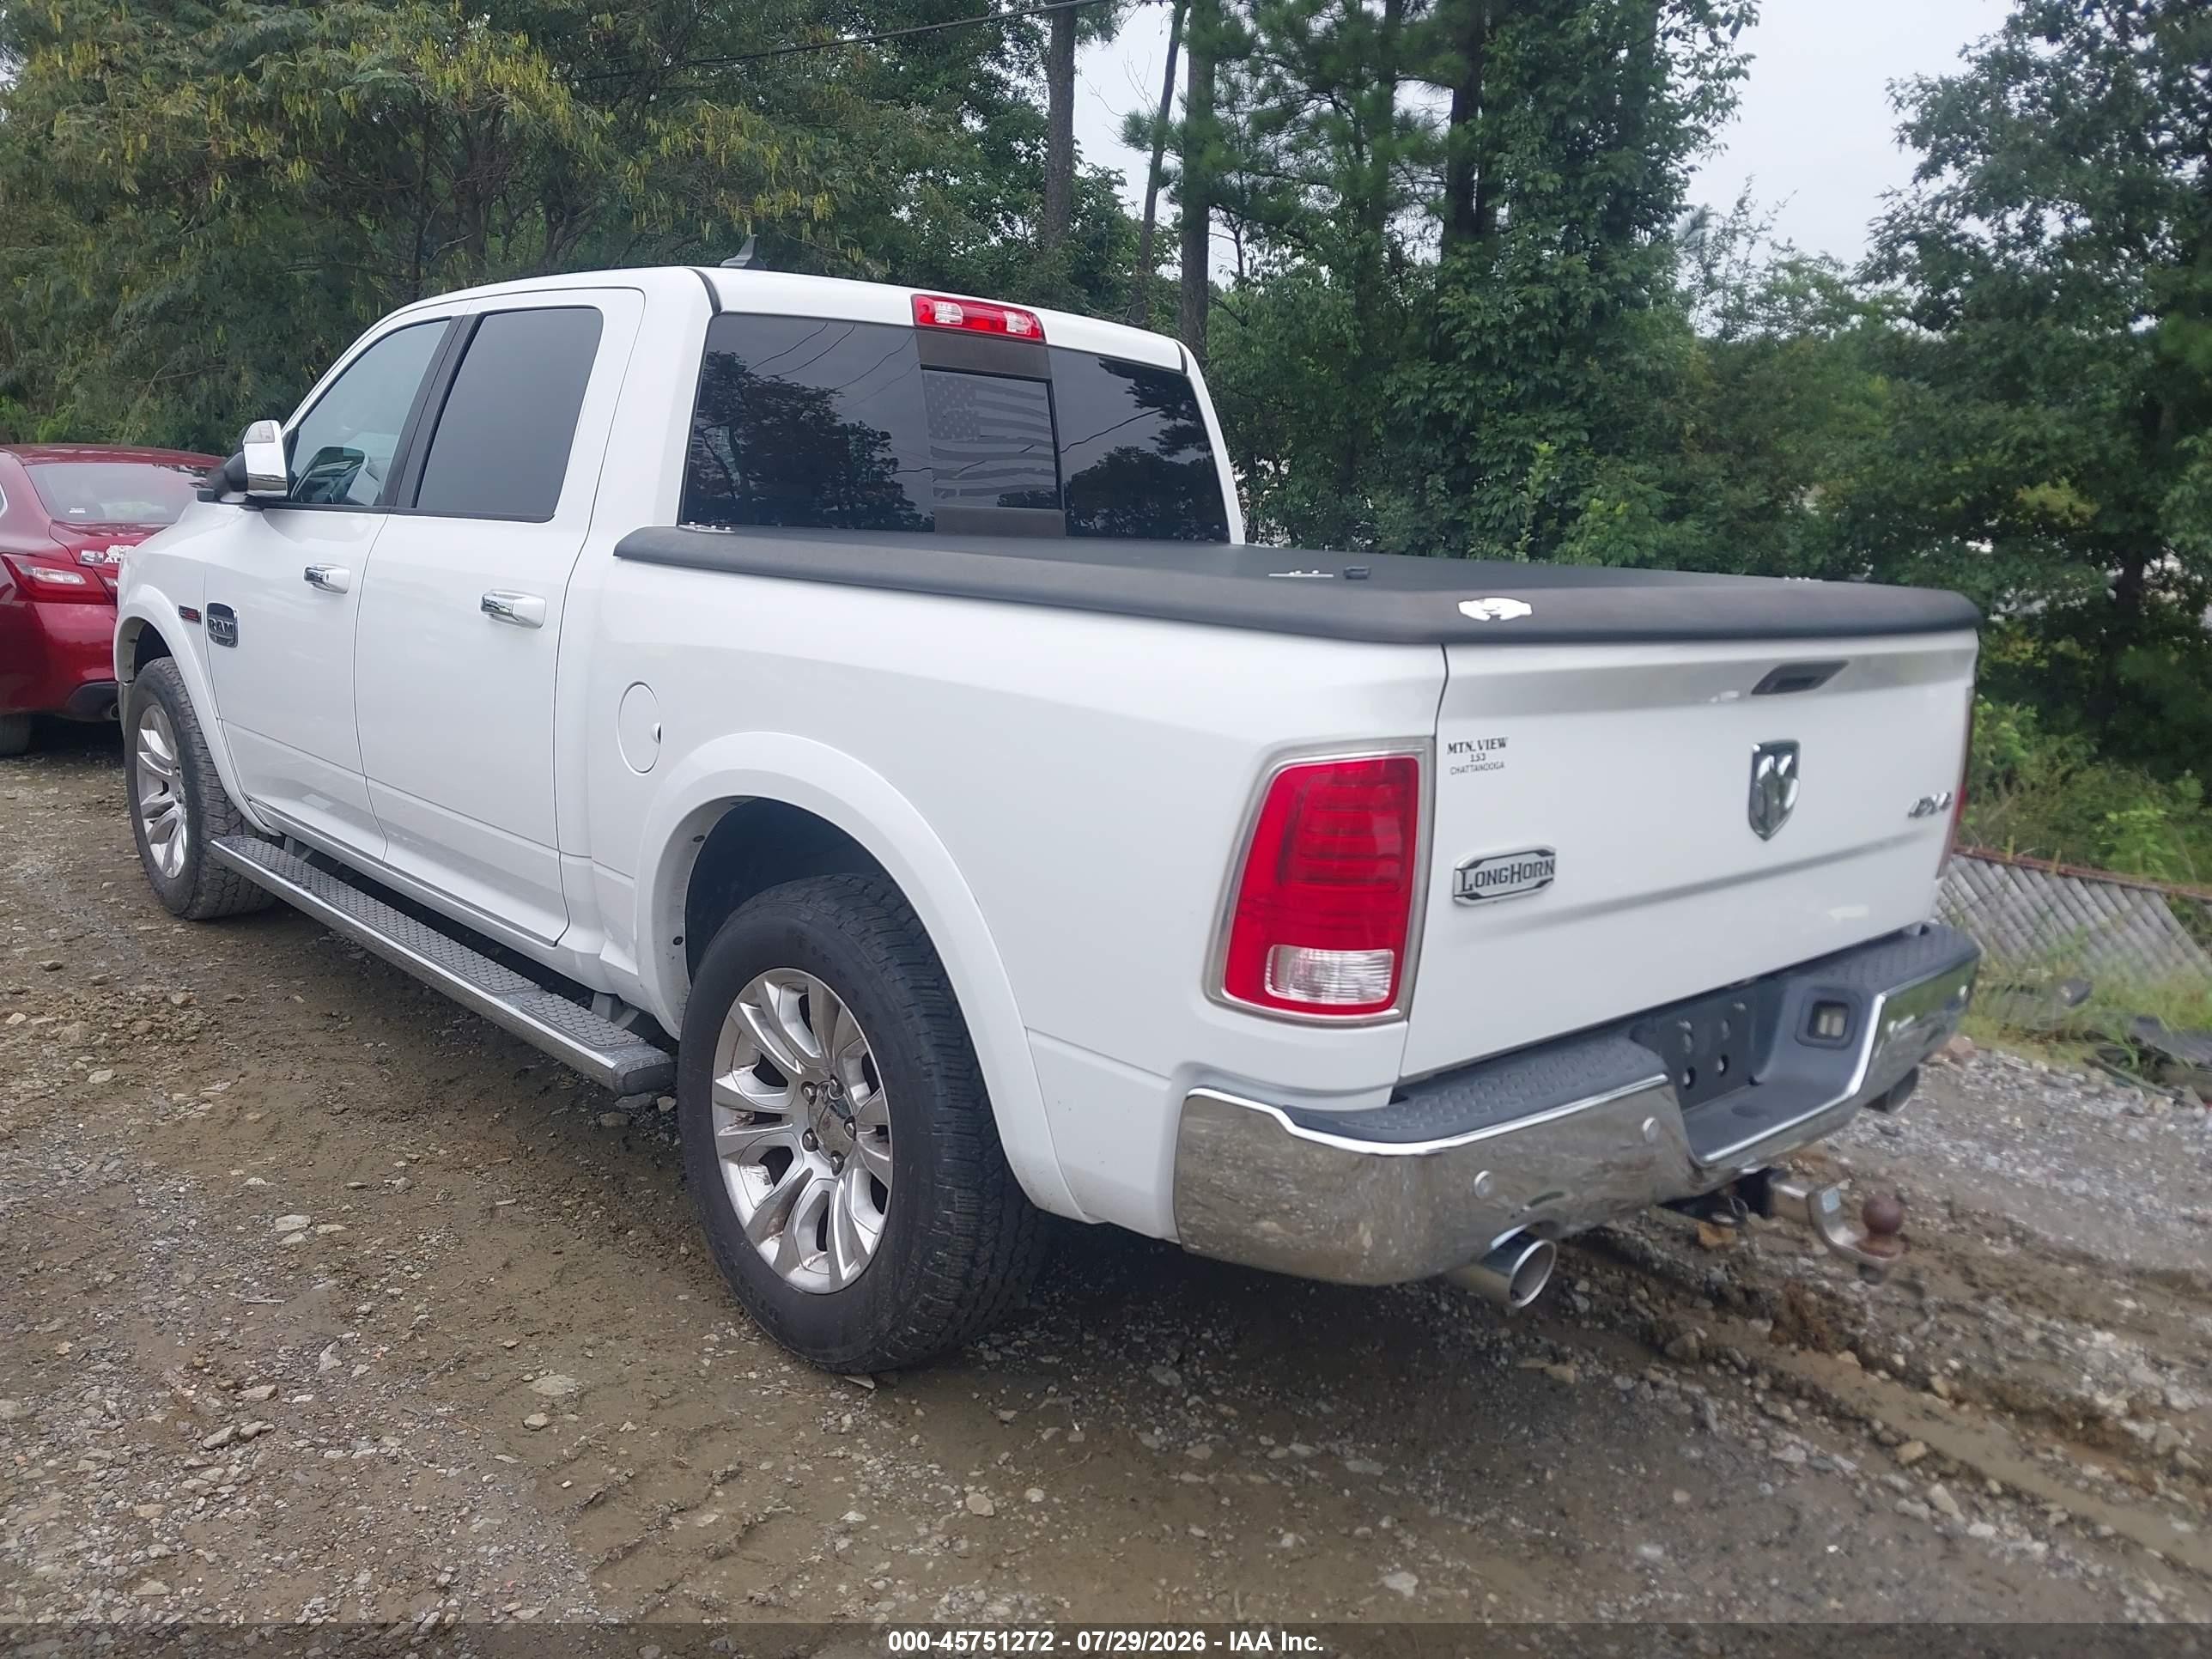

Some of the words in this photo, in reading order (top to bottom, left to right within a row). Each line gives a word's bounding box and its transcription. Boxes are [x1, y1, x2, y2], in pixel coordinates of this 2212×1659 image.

[208, 617, 234, 635] RAM
[1477, 737, 1509, 750] VIEW
[1449, 761, 1505, 775] CHATTANOOGA
[1462, 859, 1555, 892] LONGHORN
